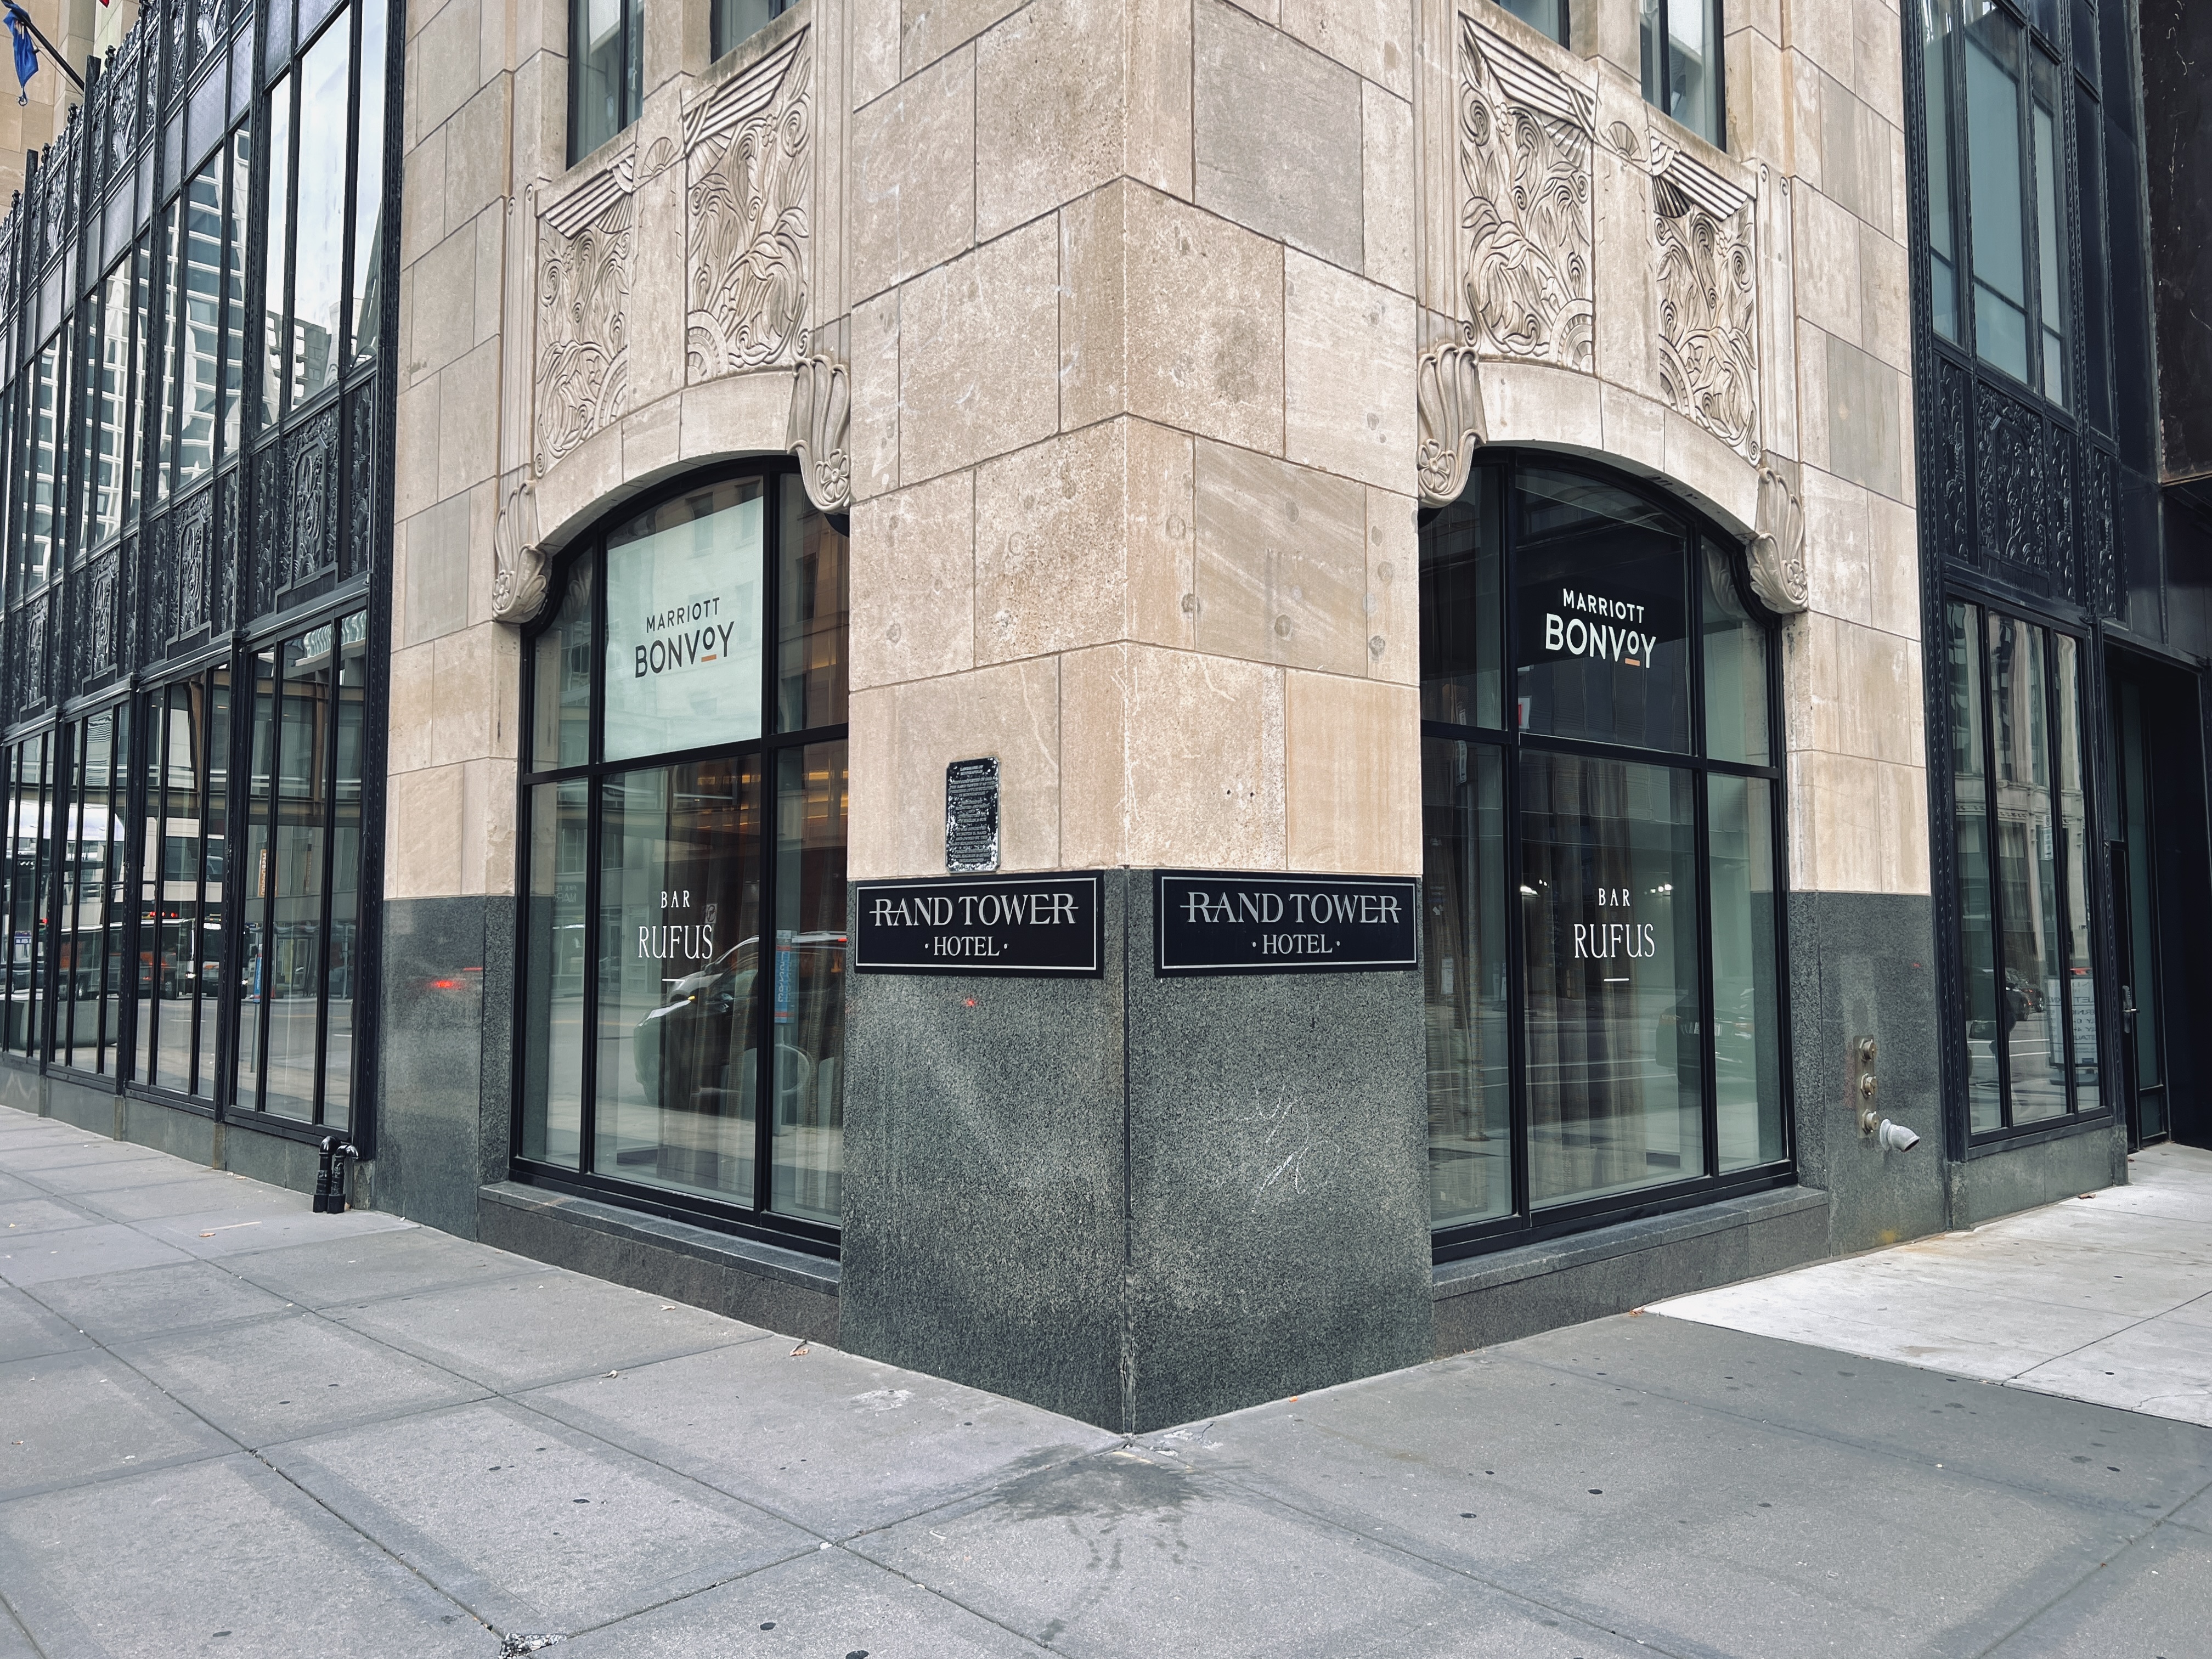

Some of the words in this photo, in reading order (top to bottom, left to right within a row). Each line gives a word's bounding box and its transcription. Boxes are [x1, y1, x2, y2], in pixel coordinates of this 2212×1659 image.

[646, 596, 720, 634] MARRIOTT
[1562, 588, 1644, 624] MARRIOTT
[635, 621, 735, 678] BONVOY
[1545, 613, 1656, 668] BONVOY
[661, 890, 690, 908] BAR
[870, 895, 953, 927] RAND
[958, 893, 1079, 927] TOWER
[1180, 891, 1284, 923] RAND
[1289, 894, 1402, 924] TOWER
[1598, 888, 1630, 906] BAR
[638, 924, 713, 960] RUFUS
[934, 936, 1000, 957] HOTEL
[1262, 933, 1333, 955] HOTEL
[1574, 923, 1655, 958] RUFUS
